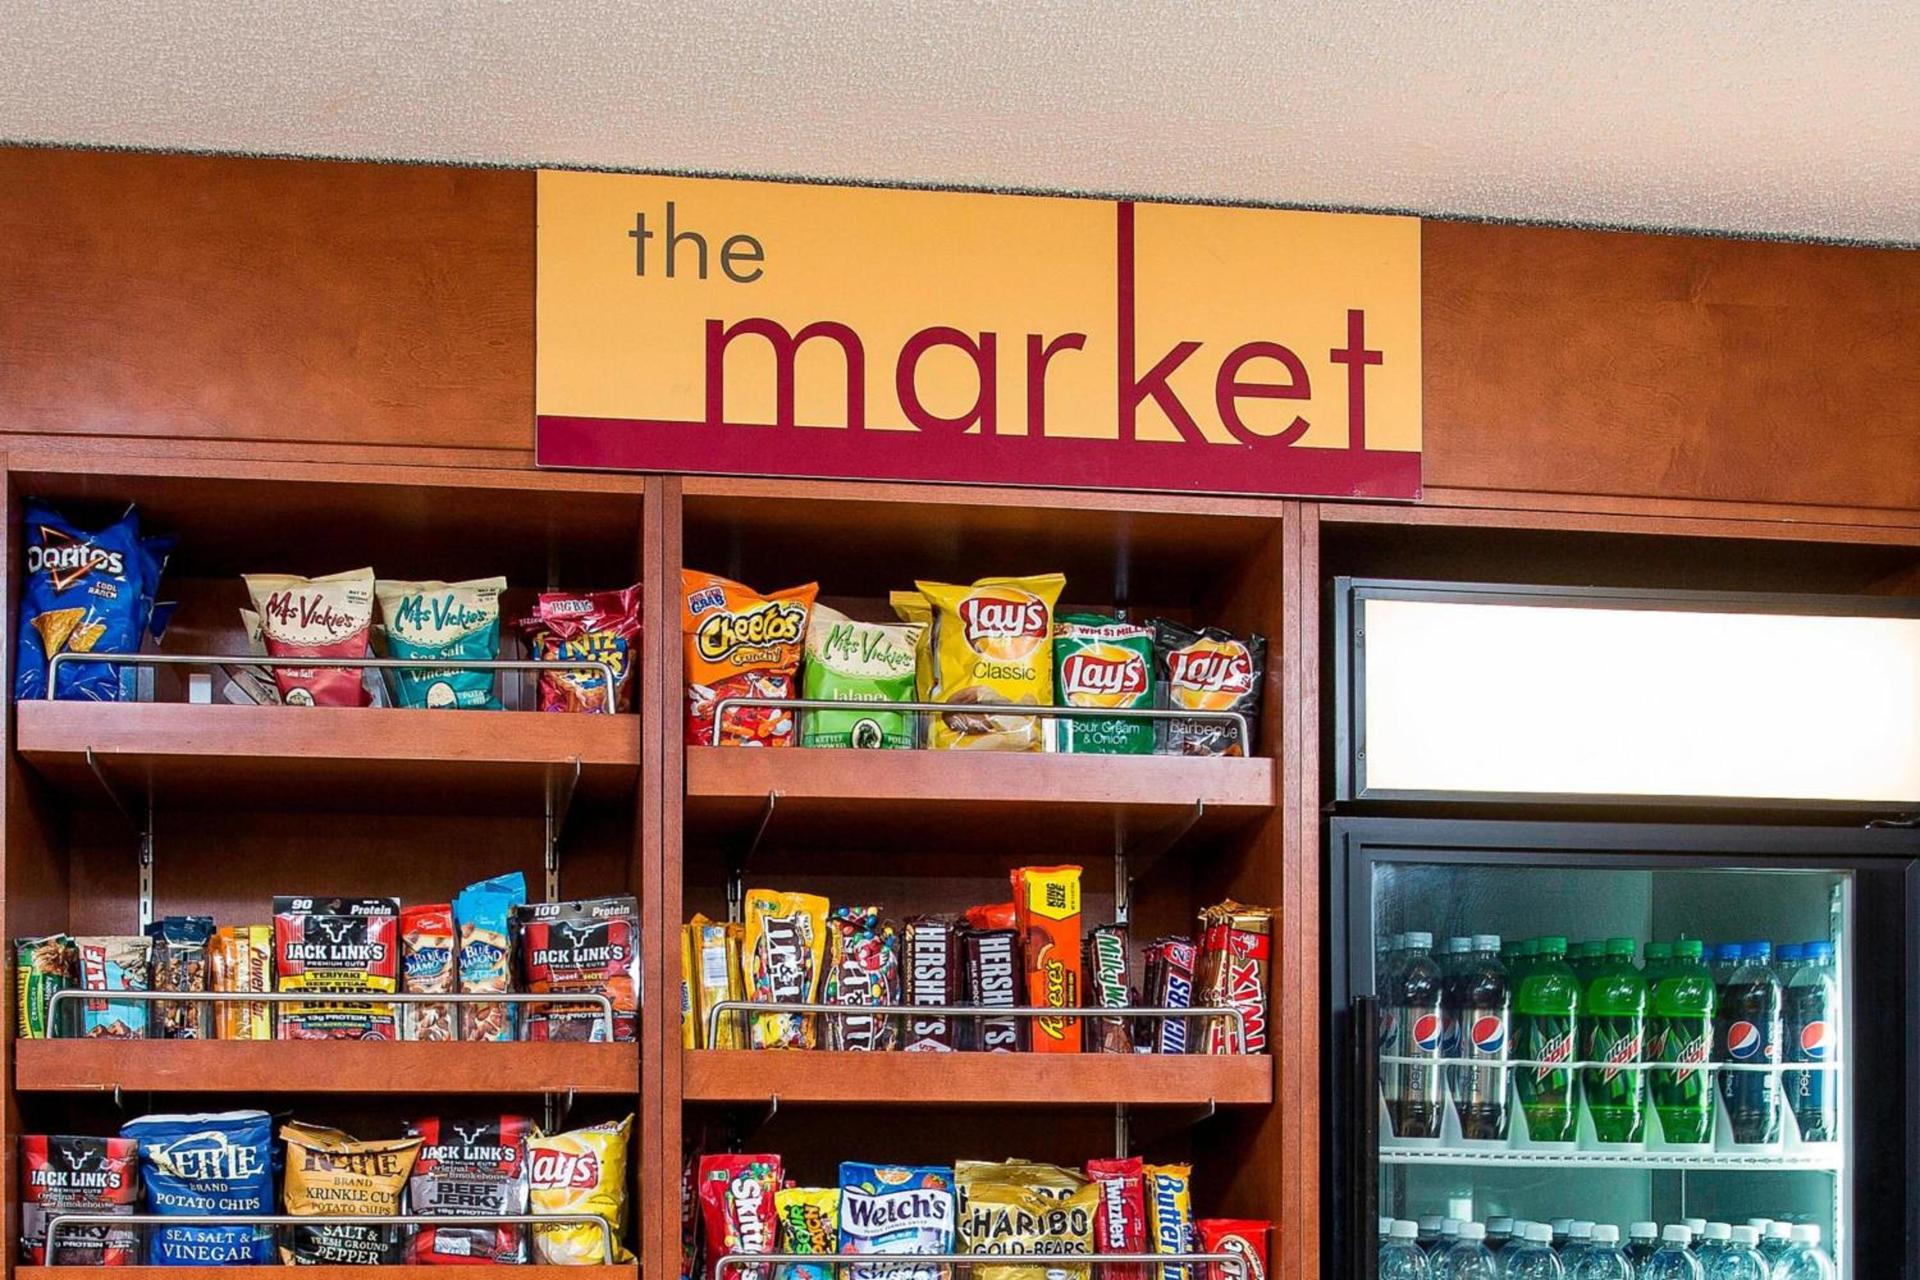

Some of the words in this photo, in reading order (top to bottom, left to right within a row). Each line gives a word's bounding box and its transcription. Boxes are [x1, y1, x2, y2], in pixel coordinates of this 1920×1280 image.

[629, 201, 765, 284] the
[705, 201, 1384, 452] market
[27, 544, 123, 574] Doritos
[299, 593, 354, 635] Vickie's
[431, 594, 488, 633] Vickie's
[968, 599, 1044, 640] Lay's
[698, 603, 804, 659] Cheetos
[441, 642, 465, 659] Salt
[972, 660, 1037, 681] Classic
[1068, 656, 1142, 694] Lay's
[1171, 654, 1247, 693] Lay's
[291, 899, 314, 910] 90
[1046, 882, 1057, 908] KING
[1056, 883, 1066, 909] SIZE
[350, 904, 392, 915] Protein
[534, 905, 561, 917] 100
[591, 904, 630, 917] Protein
[287, 944, 328, 960] JACK
[330, 943, 385, 961] LINK'S
[533, 949, 570, 966] JACK
[573, 945, 624, 962] LINK'S
[1097, 934, 1125, 986] Milky
[251, 943, 269, 1020] Powerar
[311, 971, 361, 979] TERIYAKI
[914, 926, 946, 1036] HERSHE'S
[1800, 1059, 1811, 1097] pepi
[144, 1131, 265, 1181] KETTLE
[420, 1145, 460, 1160] JACK
[463, 1145, 516, 1162] LINK'S
[30, 1170, 68, 1186] JACK
[71, 1170, 121, 1188] LINK'S
[189, 1182, 229, 1193] BRAND
[333, 1176, 373, 1187] BRAND
[437, 1181, 499, 1196] BEEF
[155, 1192, 216, 1210] POTATO
[219, 1197, 261, 1211] CHIPS
[305, 1187, 369, 1202] KRINKLE
[428, 1193, 505, 1209] JERKY
[311, 1201, 356, 1214] POTATO
[359, 1204, 392, 1216] CHIPS
[847, 1193, 946, 1227] Welch's
[1104, 1175, 1128, 1249] Twizzlers
[973, 1207, 1088, 1238] HARIBO
[166, 1229, 193, 1242] SEA
[196, 1231, 236, 1244] SALT
[239, 1233, 251, 1244] &
[322, 1224, 367, 1240] SALT
[367, 1230, 379, 1242] &
[162, 1243, 253, 1262] VINEGAR
[317, 1245, 380, 1265] PEPPER
[343, 1239, 389, 1252] GROUND
[973, 1241, 1086, 1255] GOLD-BEARS
